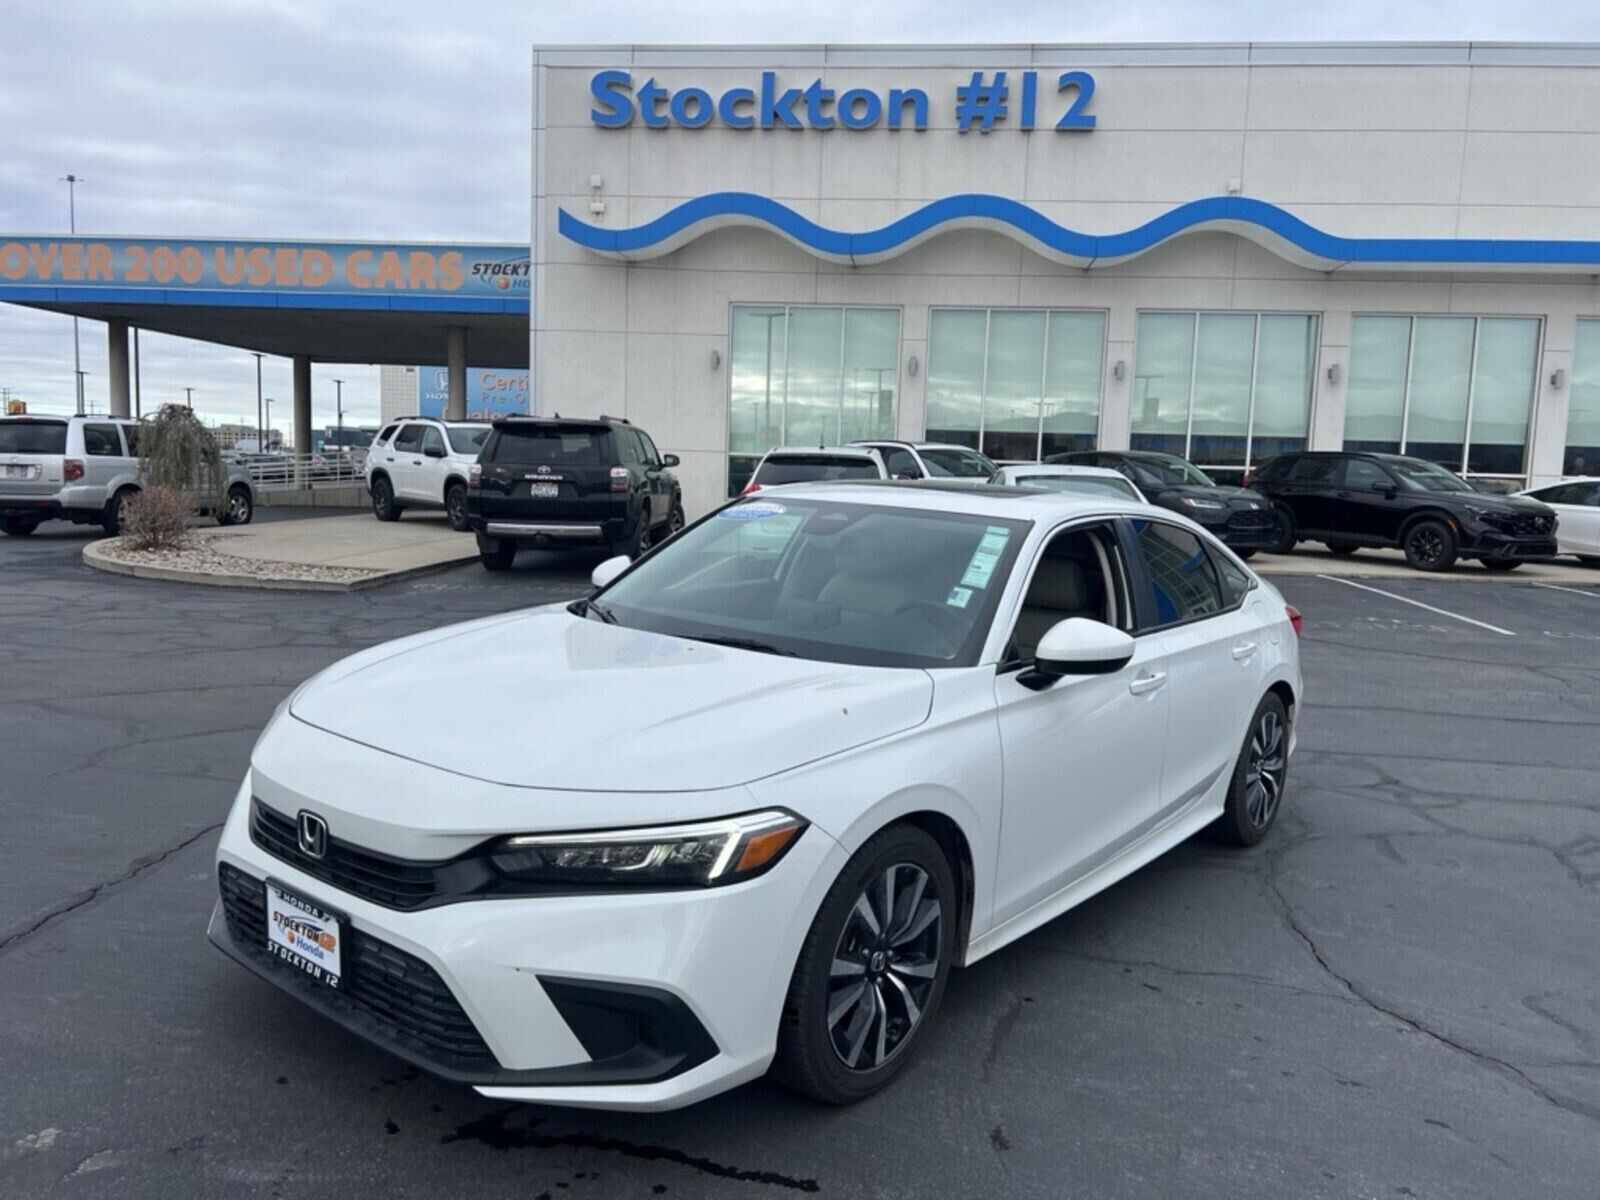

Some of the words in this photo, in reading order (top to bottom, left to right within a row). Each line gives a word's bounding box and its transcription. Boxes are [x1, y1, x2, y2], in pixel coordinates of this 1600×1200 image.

[590, 69, 929, 131] Stockton
[955, 70, 1097, 134] #12
[0, 242, 113, 281] OVER
[125, 245, 204, 284] 200
[215, 246, 334, 288] USED
[346, 249, 465, 291] CARS
[283, 892, 319, 917] HONDA
[267, 940, 322, 979] STOCKTON
[326, 974, 339, 988] 12
[296, 936, 324, 960] Honda
